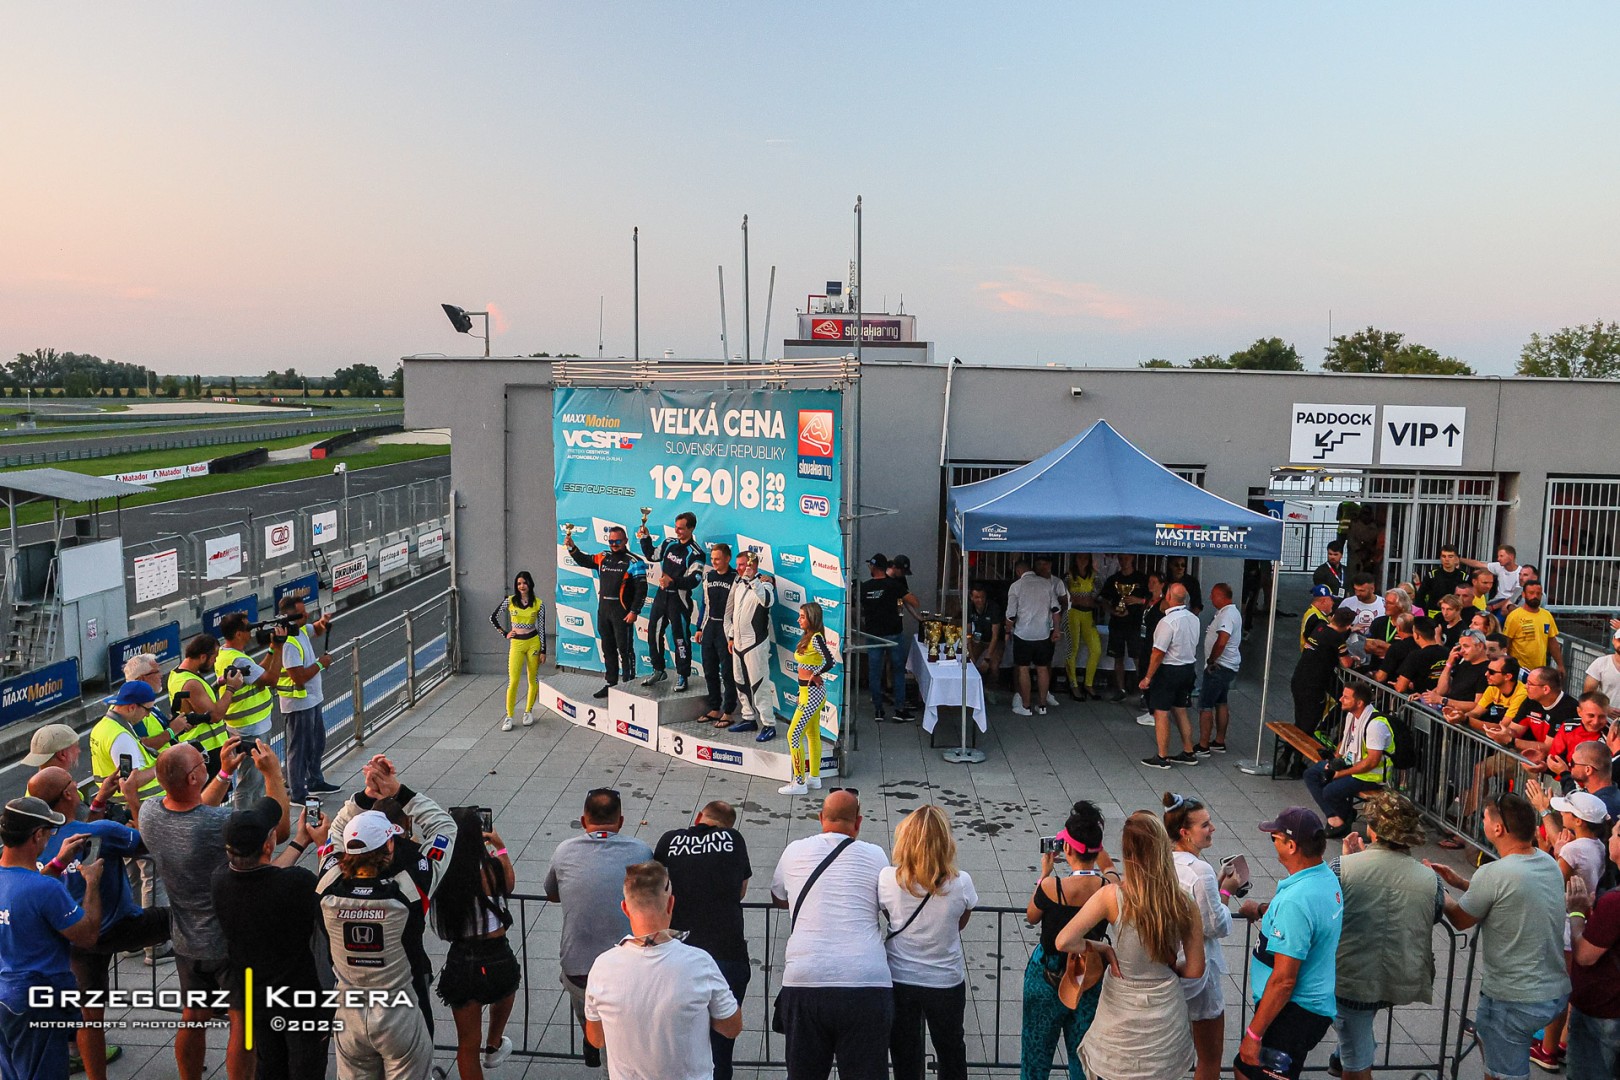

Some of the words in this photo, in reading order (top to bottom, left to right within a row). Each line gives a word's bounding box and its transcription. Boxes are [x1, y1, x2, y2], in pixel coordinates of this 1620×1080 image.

[650, 402, 719, 436] VEĽKÁ
[724, 409, 786, 439] CENA
[1297, 412, 1372, 425] PADDOCK
[562, 429, 621, 449] VCSR
[1388, 422, 1438, 446] VIP
[665, 441, 728, 457] SLOVENSKEJ
[730, 444, 786, 461] REPUBLIKY
[563, 483, 586, 492] ESET
[587, 485, 605, 494] CUP
[606, 486, 636, 497] SERIES
[649, 464, 733, 506] 19-20
[740, 471, 760, 504] 8
[1155, 539, 1191, 549] building
[1156, 529, 1247, 542] MASTERTENT
[587, 709, 596, 727] 2
[629, 704, 635, 721] 1
[674, 736, 683, 755] 3
[668, 841, 733, 857] RACING
[338, 908, 384, 919] ZAGÓRSKI
